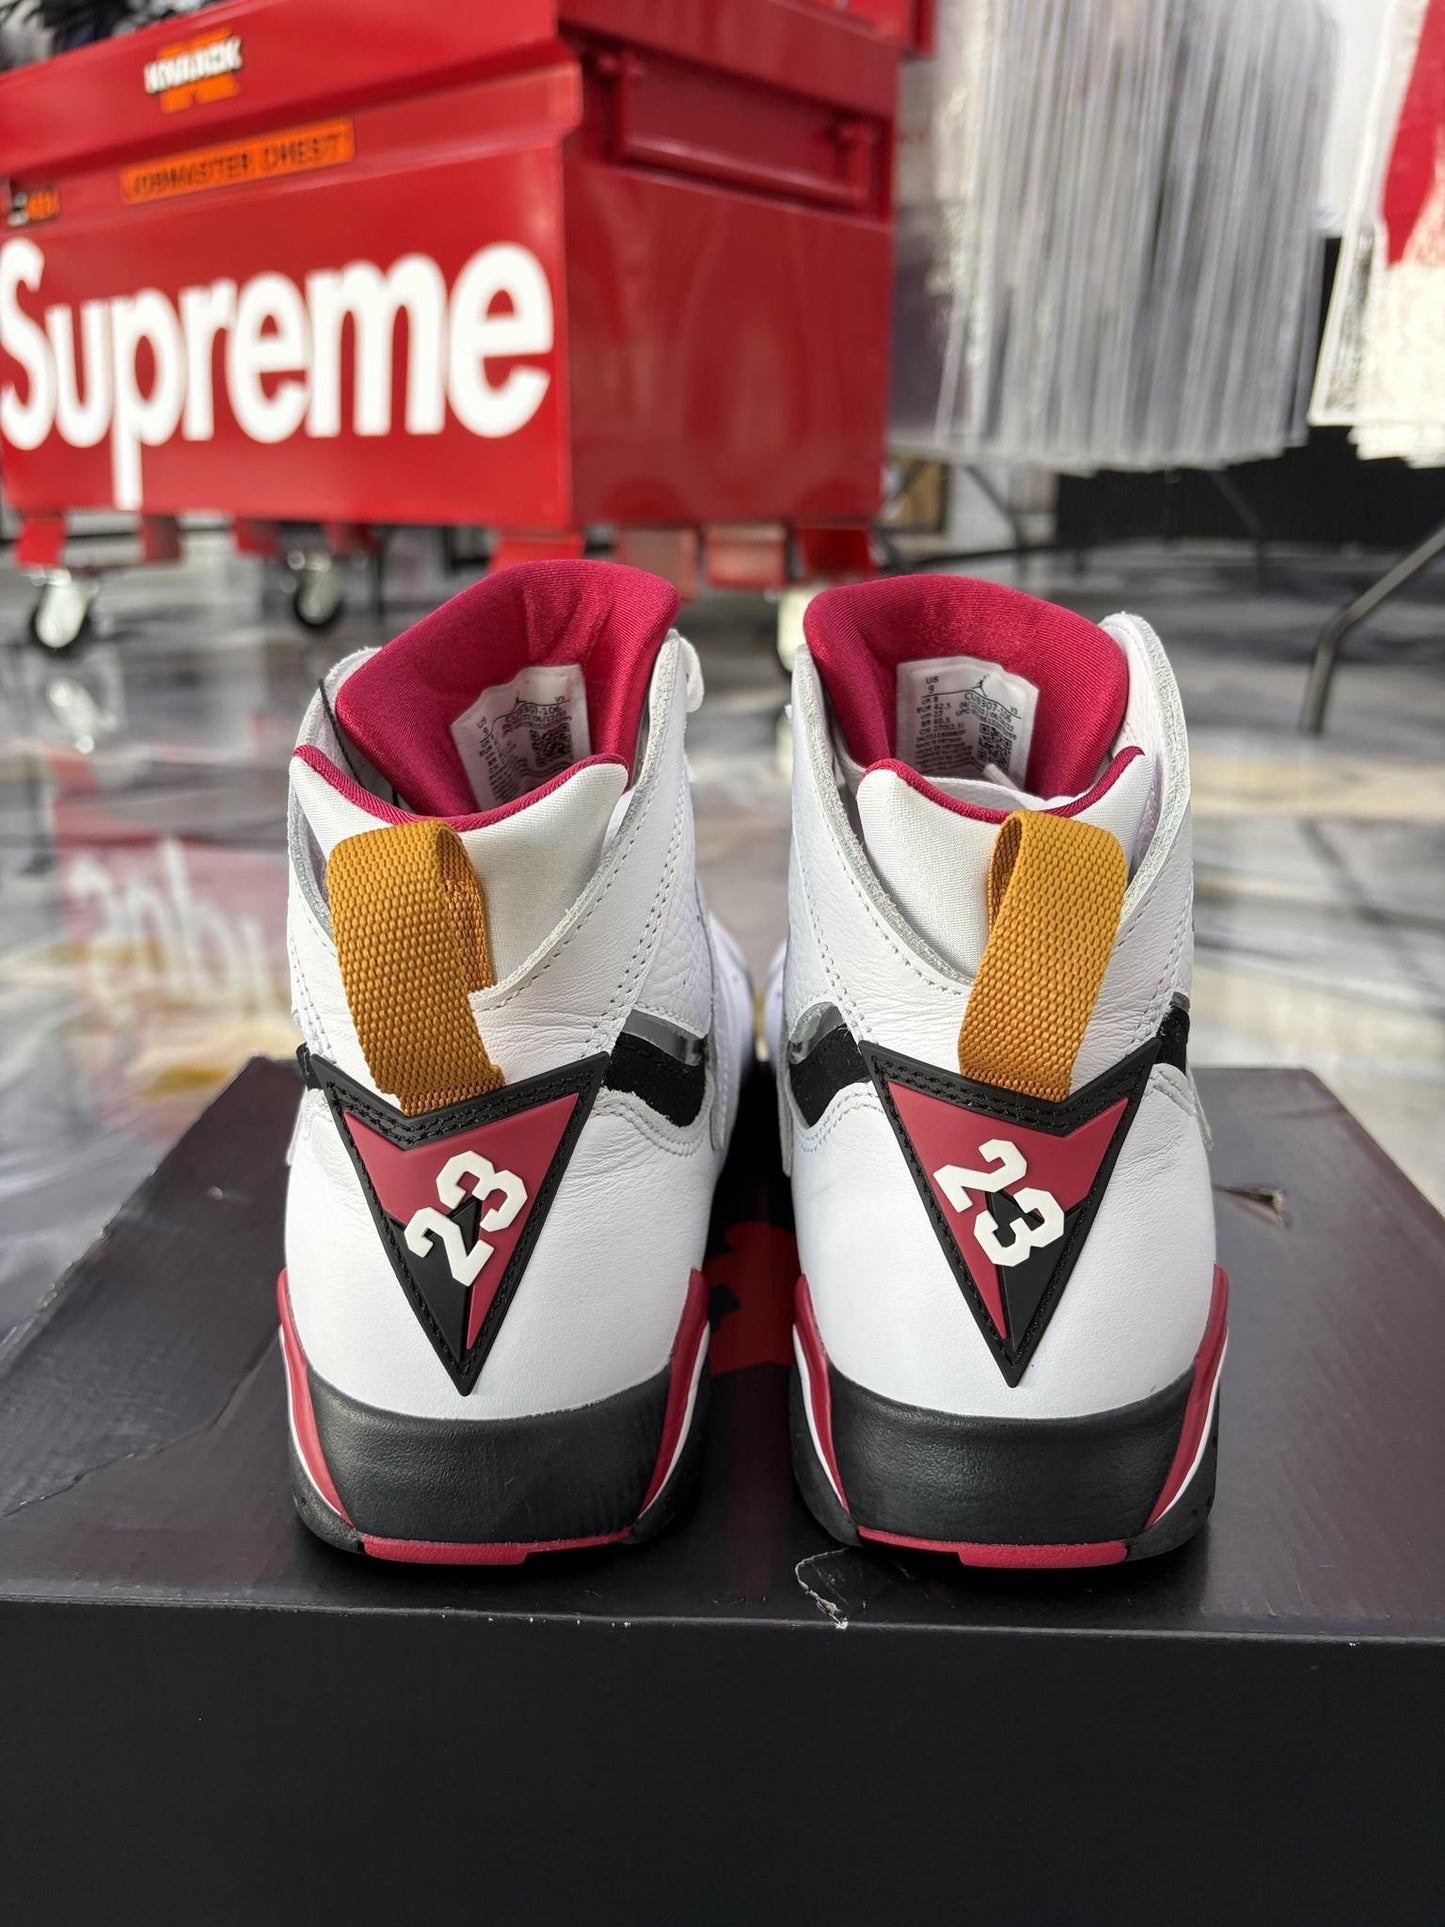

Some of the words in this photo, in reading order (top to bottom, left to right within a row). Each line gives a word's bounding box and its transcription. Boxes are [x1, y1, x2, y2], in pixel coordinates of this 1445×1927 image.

[0, 236, 554, 511] Supreme
[404, 1150, 528, 1287] 23
[933, 1139, 1065, 1267] 23
